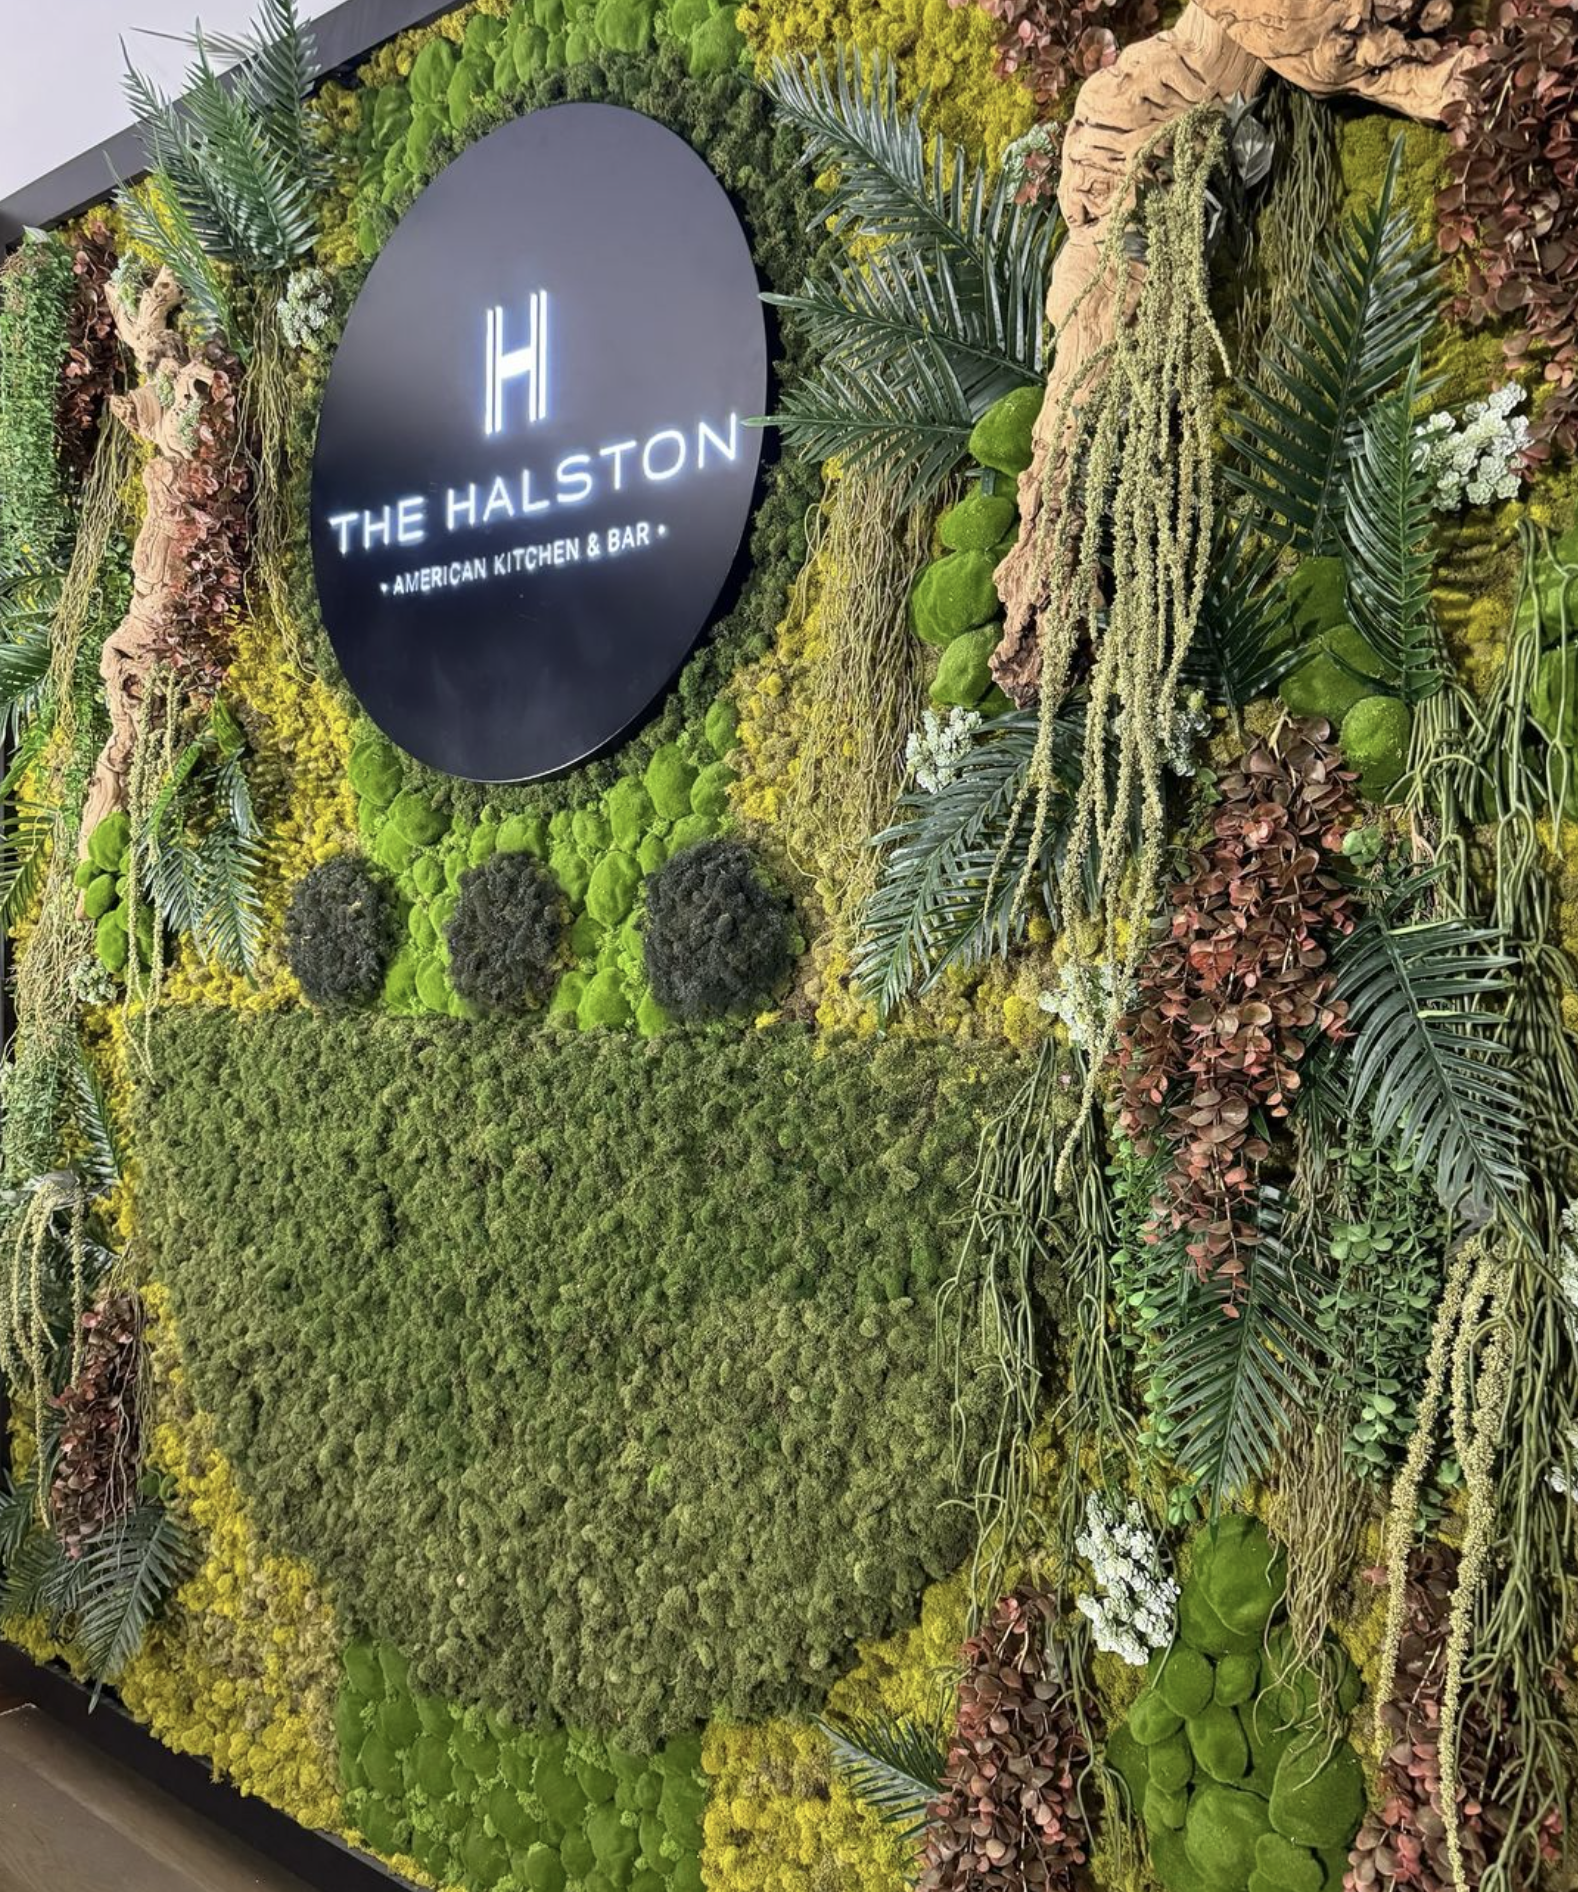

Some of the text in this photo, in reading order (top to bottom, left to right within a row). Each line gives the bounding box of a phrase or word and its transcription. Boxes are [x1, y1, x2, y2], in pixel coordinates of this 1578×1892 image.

[485, 290, 547, 435] H
[328, 411, 738, 556] THE HALSTON
[392, 521, 651, 596] AMERICAN KITCHEN & BAR
